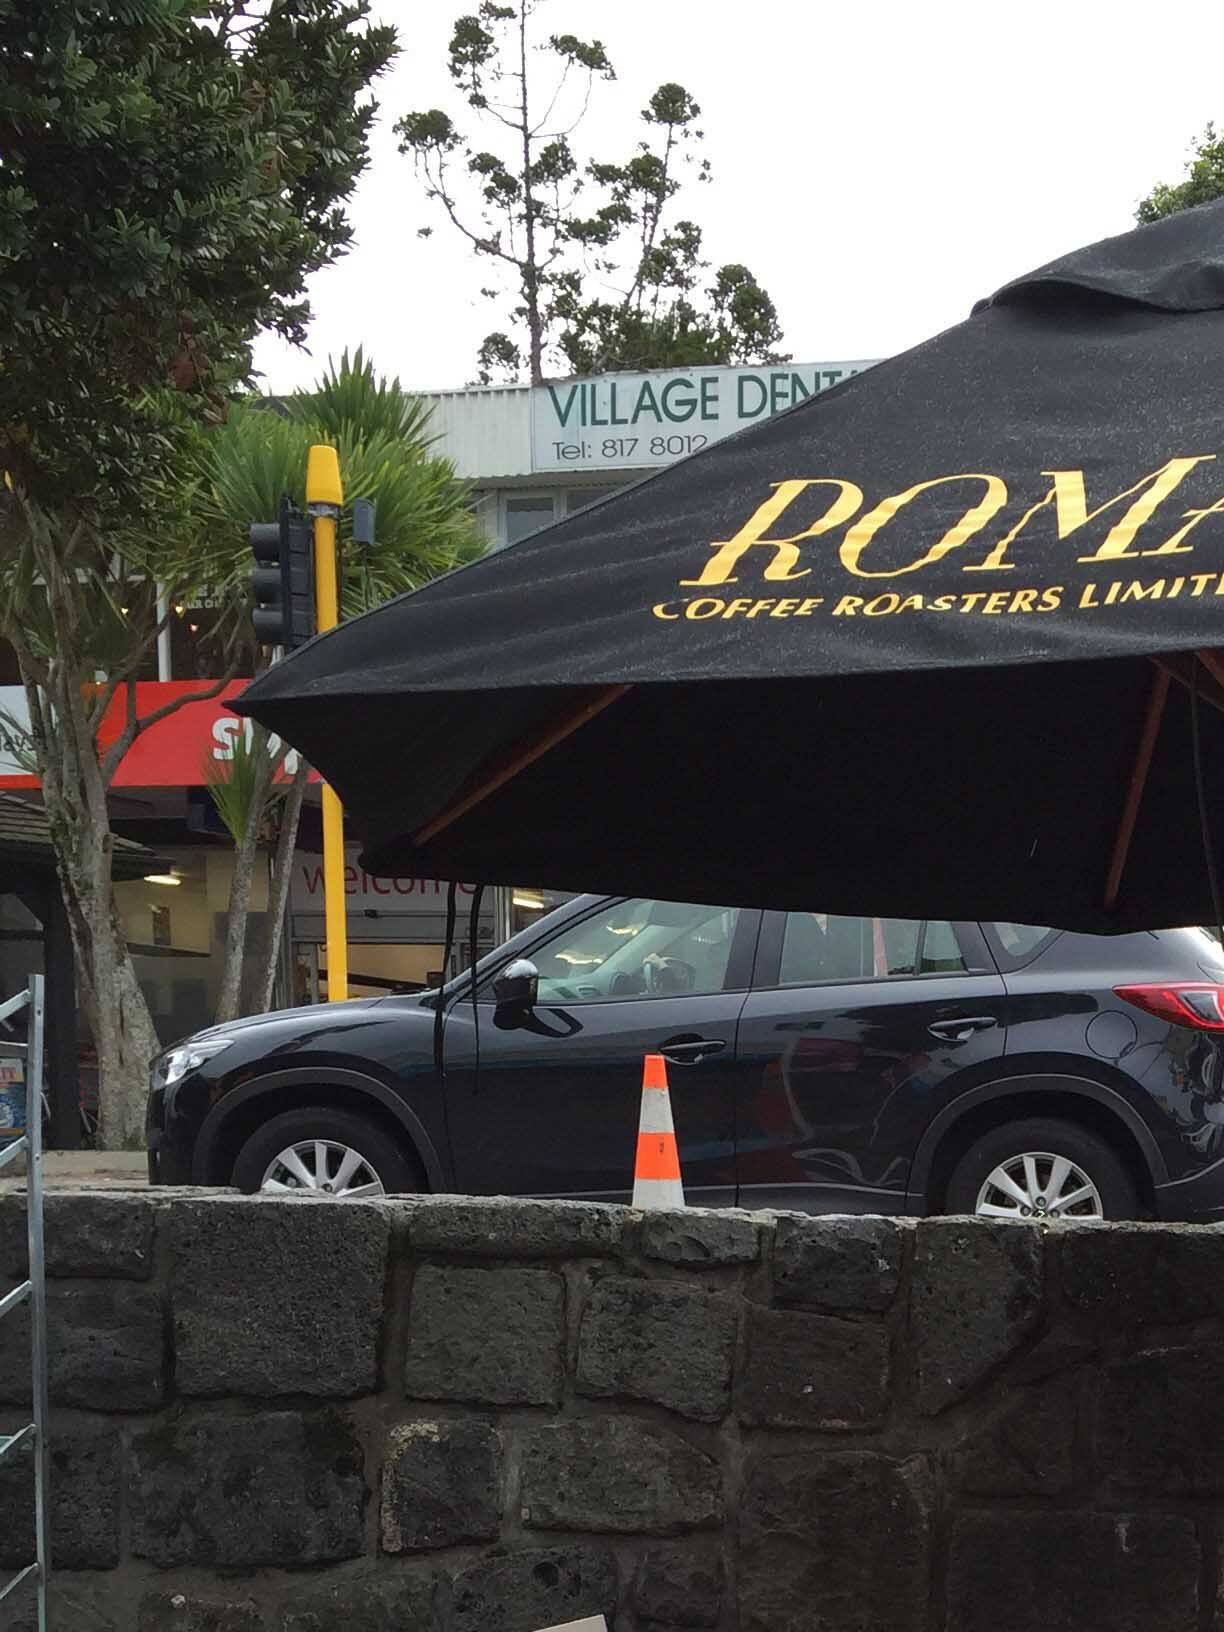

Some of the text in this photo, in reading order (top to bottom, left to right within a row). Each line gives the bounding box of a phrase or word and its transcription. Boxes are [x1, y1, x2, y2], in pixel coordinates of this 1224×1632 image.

[548, 369, 859, 428] VILLAGE DEN
[552, 434, 708, 460] Tel: 817 8012
[652, 596, 825, 620] COFFEE
[832, 586, 1065, 617] ROASTERS
